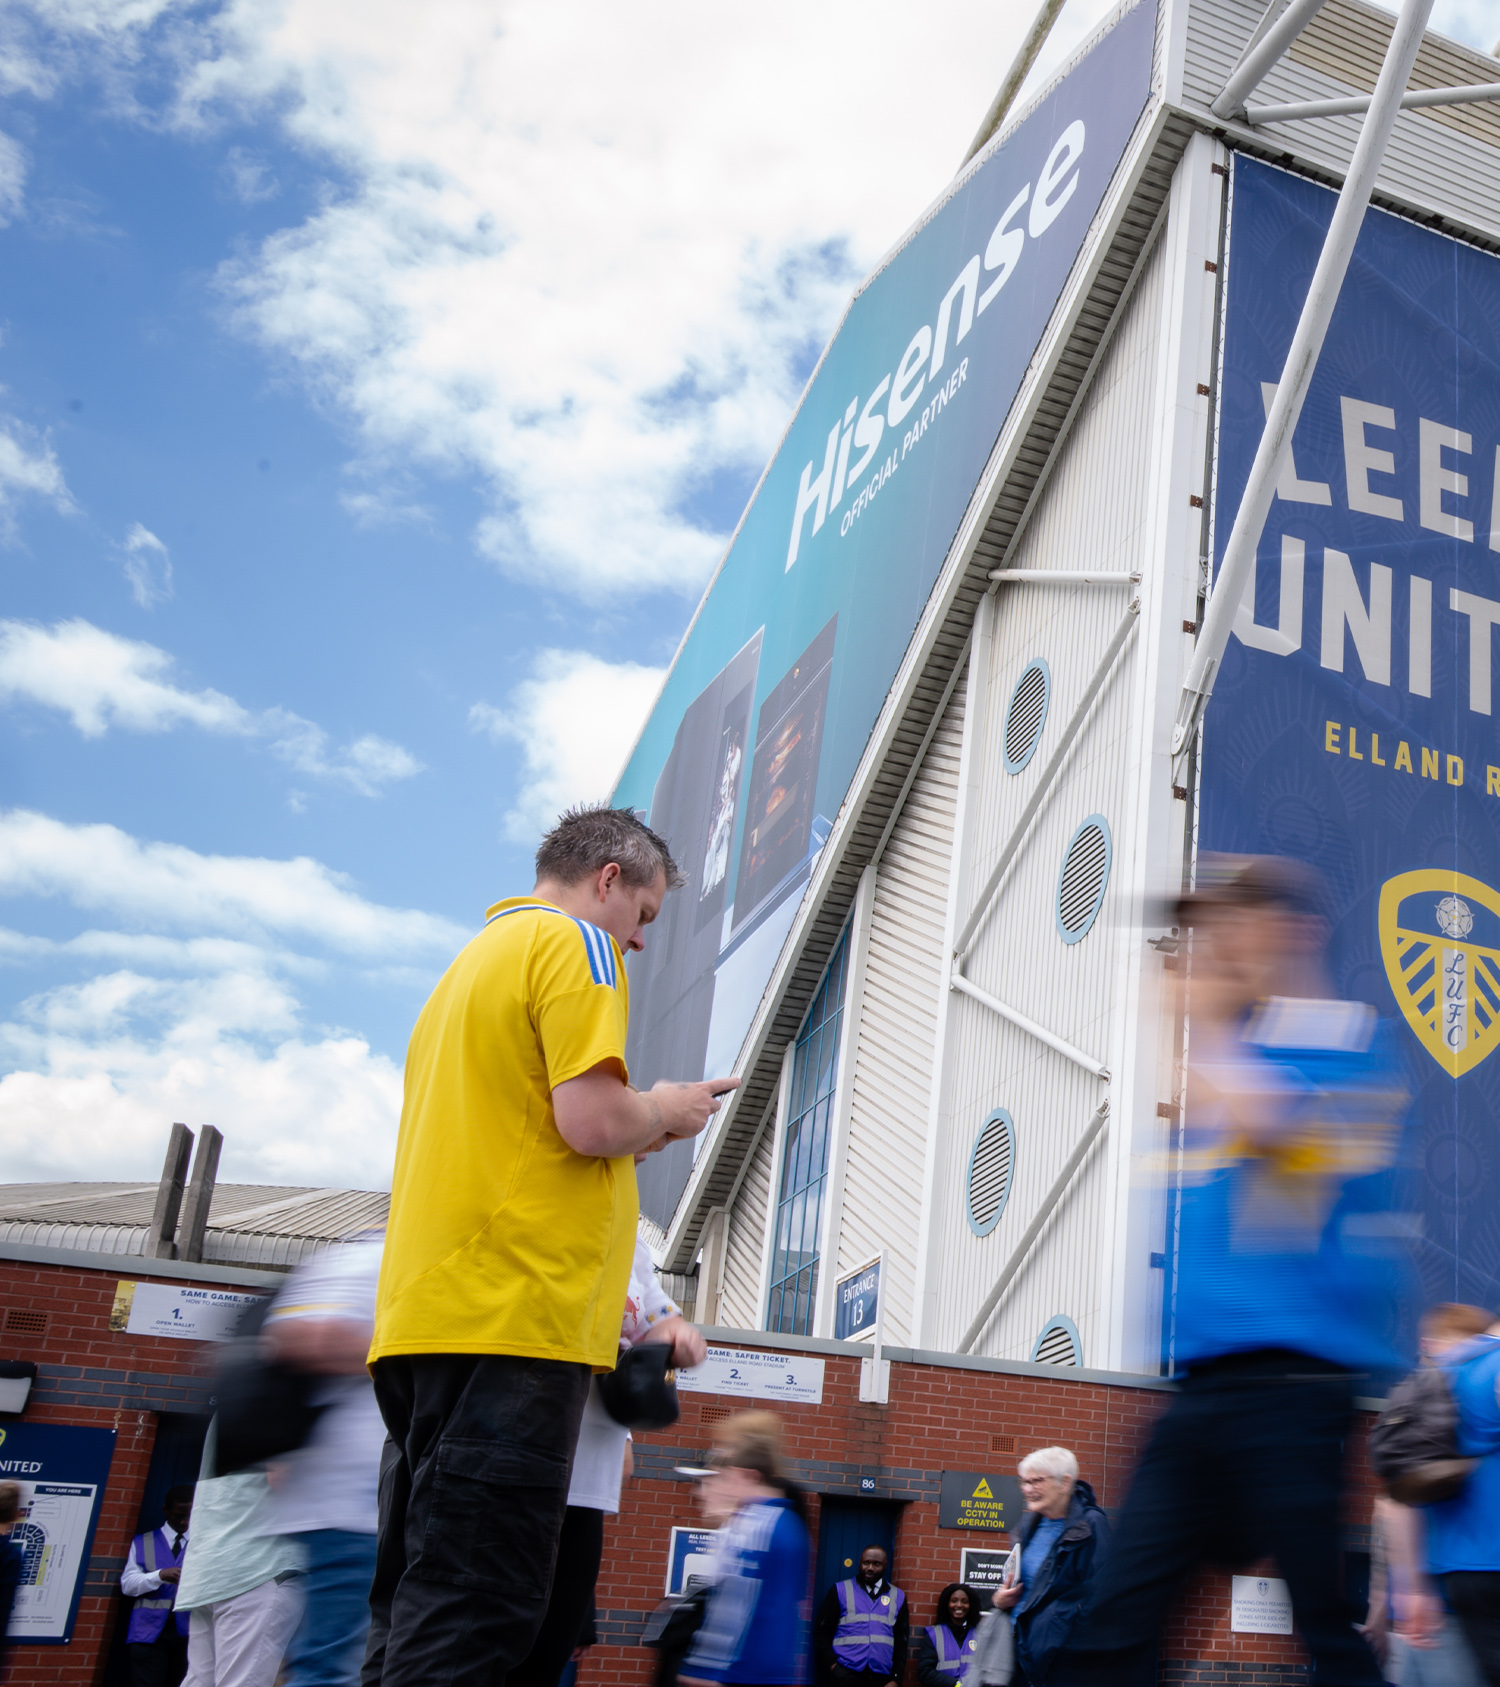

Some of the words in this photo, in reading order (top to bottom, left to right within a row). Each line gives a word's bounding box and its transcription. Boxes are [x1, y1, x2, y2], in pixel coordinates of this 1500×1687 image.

[784, 118, 1086, 575] Hisense
[840, 447, 899, 538] OFFICIAL
[901, 356, 969, 461] PARTNER
[1325, 720, 1464, 787] ELLAND
[180, 1289, 207, 1299] SAME
[843, 1273, 876, 1304] ENTRANCE
[171, 1308, 183, 1320] 1.
[853, 1299, 864, 1327] 13
[707, 1349, 733, 1358] GAME.
[735, 1352, 760, 1360] SAFER
[762, 1354, 791, 1364] TICKET.
[729, 1368, 742, 1380] 2.
[785, 1374, 797, 1386] 3.
[861, 1478, 875, 1489] 86
[960, 1499, 972, 1508] BE
[974, 1501, 1004, 1511] AWARE
[965, 1509, 988, 1518] CCTV
[989, 1511, 998, 1519] IN
[957, 1517, 1005, 1528] OPERATION
[969, 1570, 987, 1580] STAY
[987, 1572, 1002, 1581] OFF
